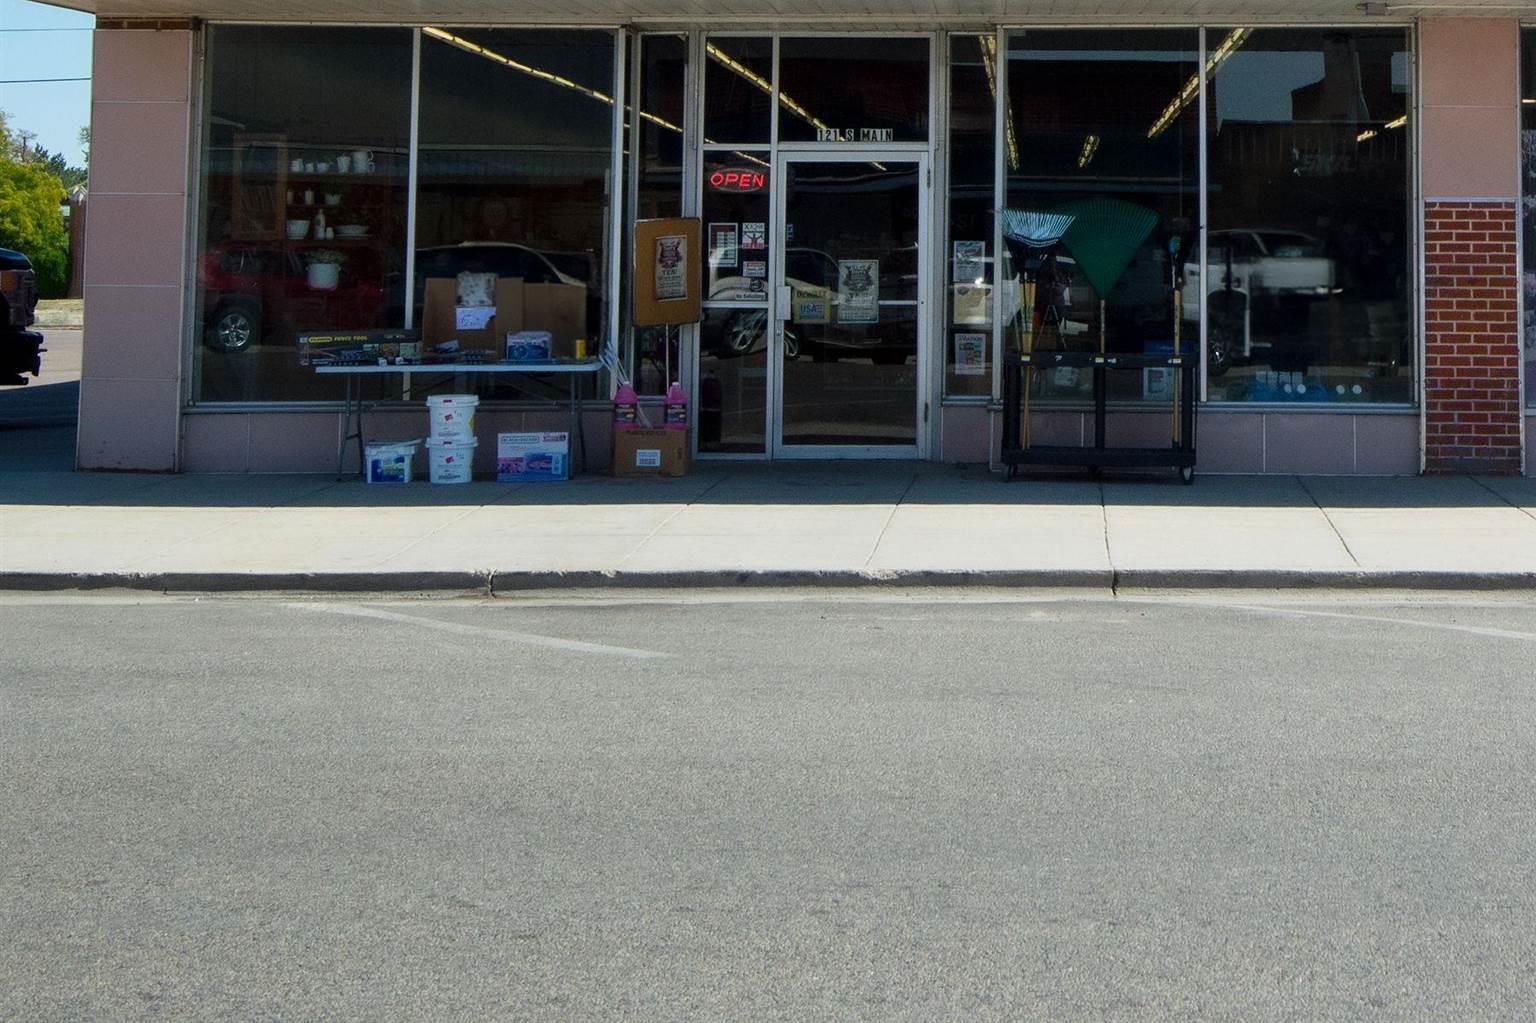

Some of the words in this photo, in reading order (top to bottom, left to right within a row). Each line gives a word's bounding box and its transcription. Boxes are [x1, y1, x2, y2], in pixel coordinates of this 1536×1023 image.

[817, 129, 839, 141] 121
[846, 129, 854, 141] S
[861, 129, 892, 141] MAIN
[710, 172, 764, 187] OPEN
[800, 303, 816, 313] USA
